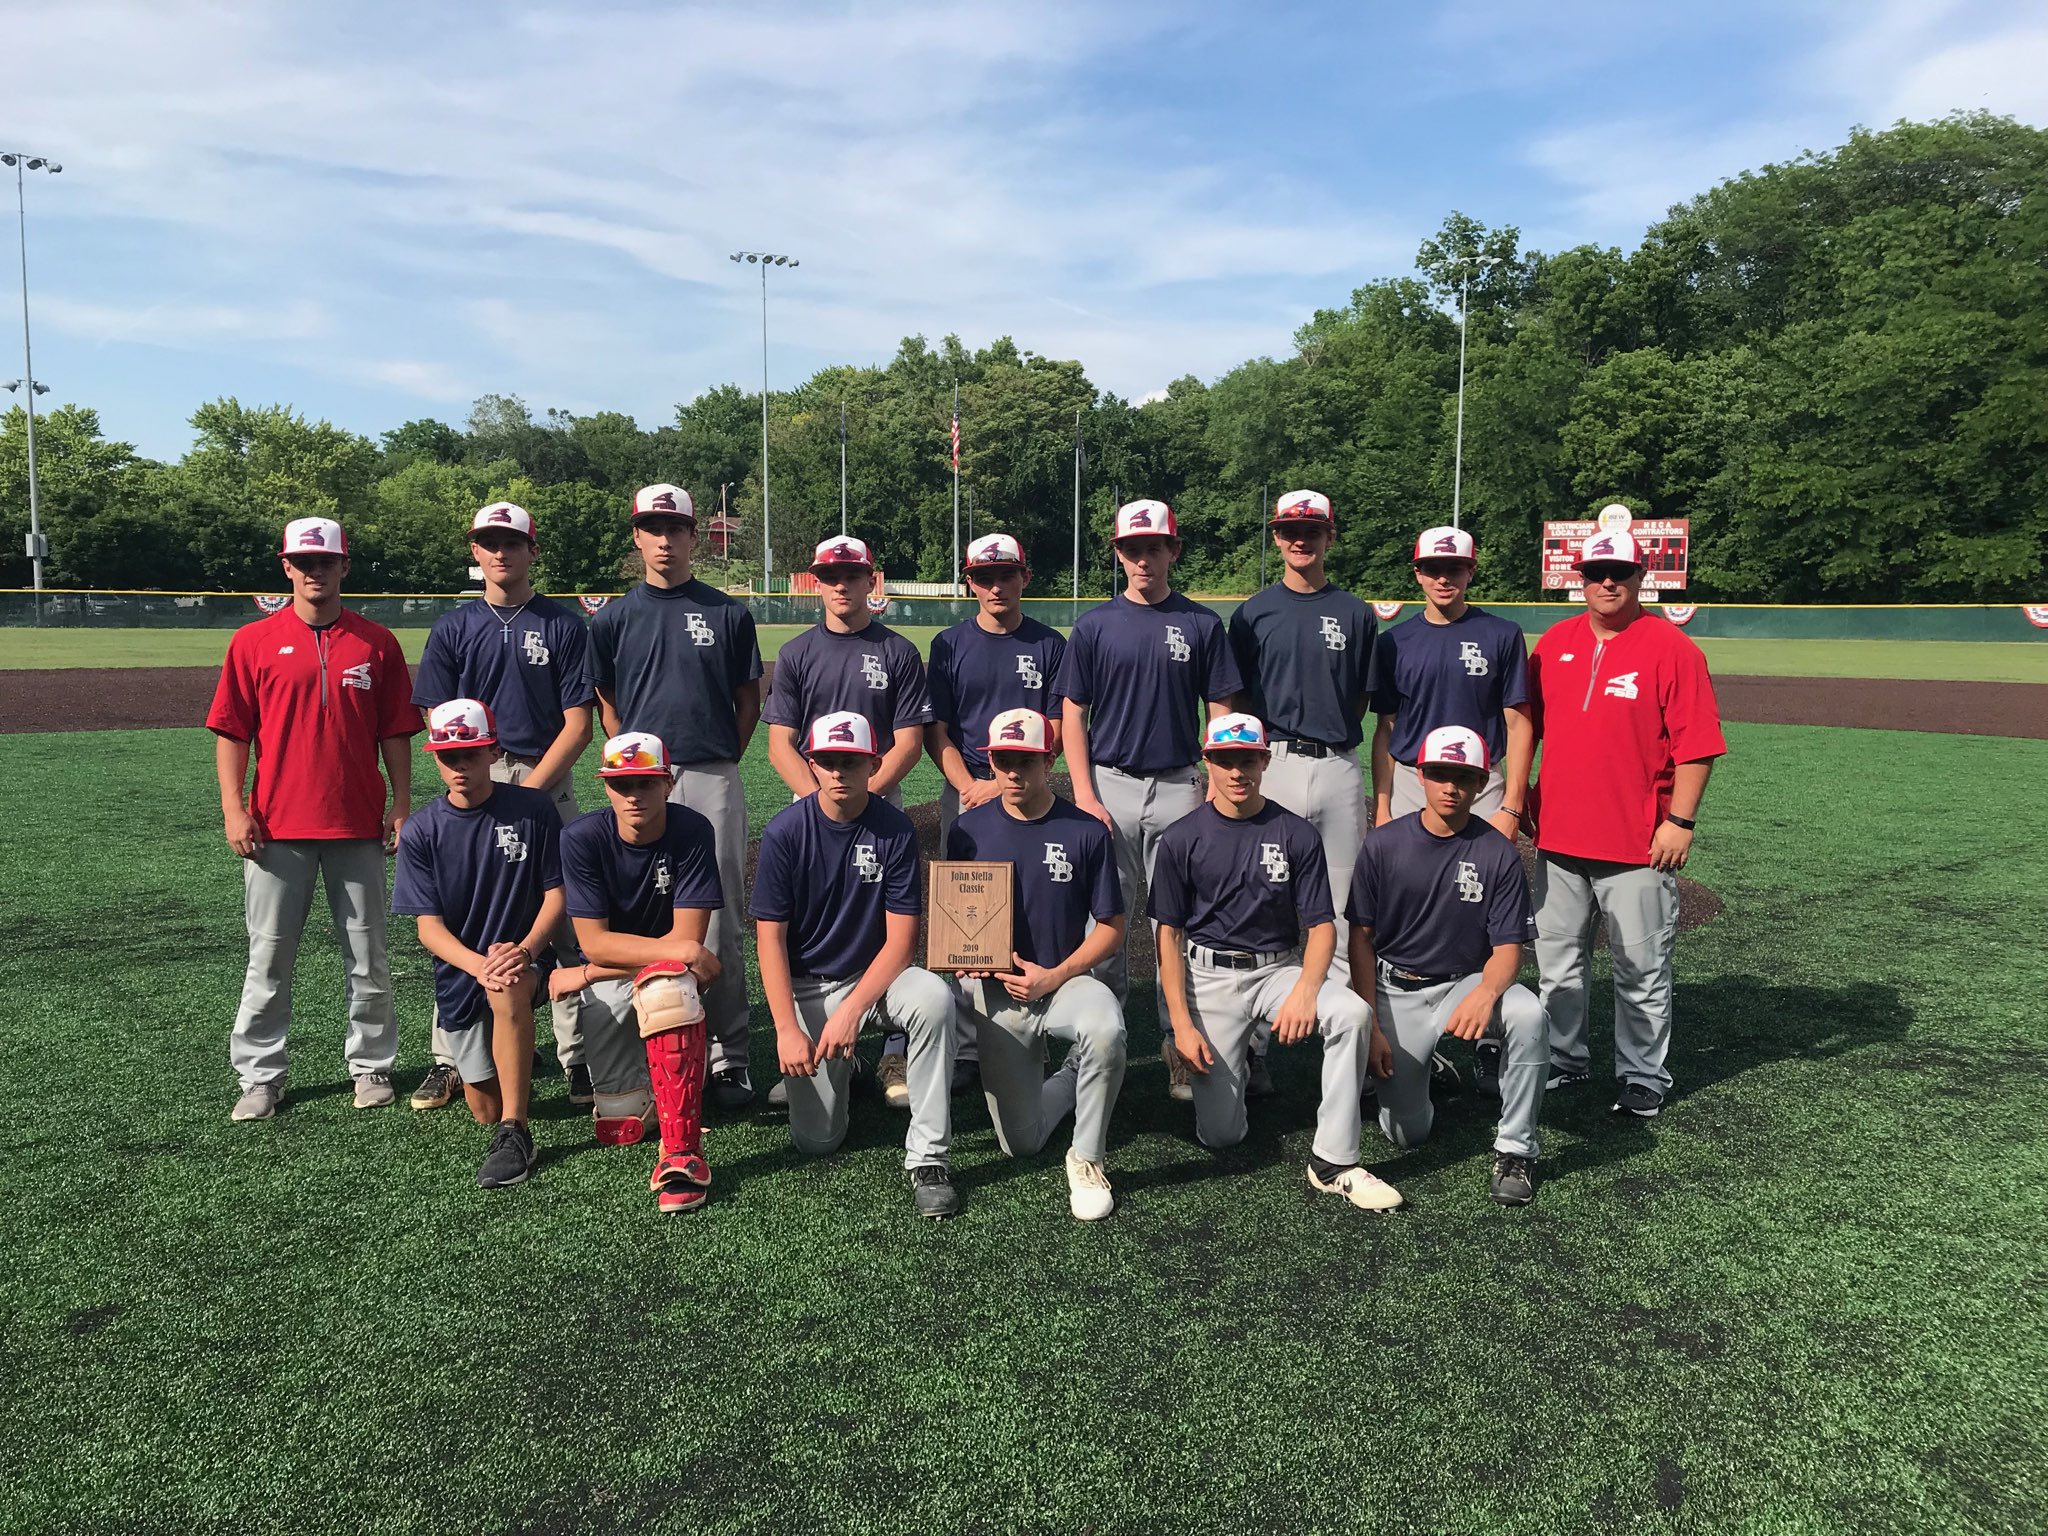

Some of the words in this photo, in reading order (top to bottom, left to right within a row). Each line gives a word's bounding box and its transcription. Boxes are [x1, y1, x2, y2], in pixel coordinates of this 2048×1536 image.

[1548, 522, 1596, 530] ELECTRICIANS
[1551, 529, 1575, 537] LOCAL
[1577, 529, 1592, 537] #22
[1640, 590, 1656, 598] ELD
[342, 678, 371, 690] FSB
[1604, 686, 1638, 699] FSB
[951, 871, 969, 882] John
[971, 871, 993, 881] Stella
[959, 883, 985, 893] Classic
[962, 944, 979, 952] 2019
[947, 954, 994, 965] Champions
